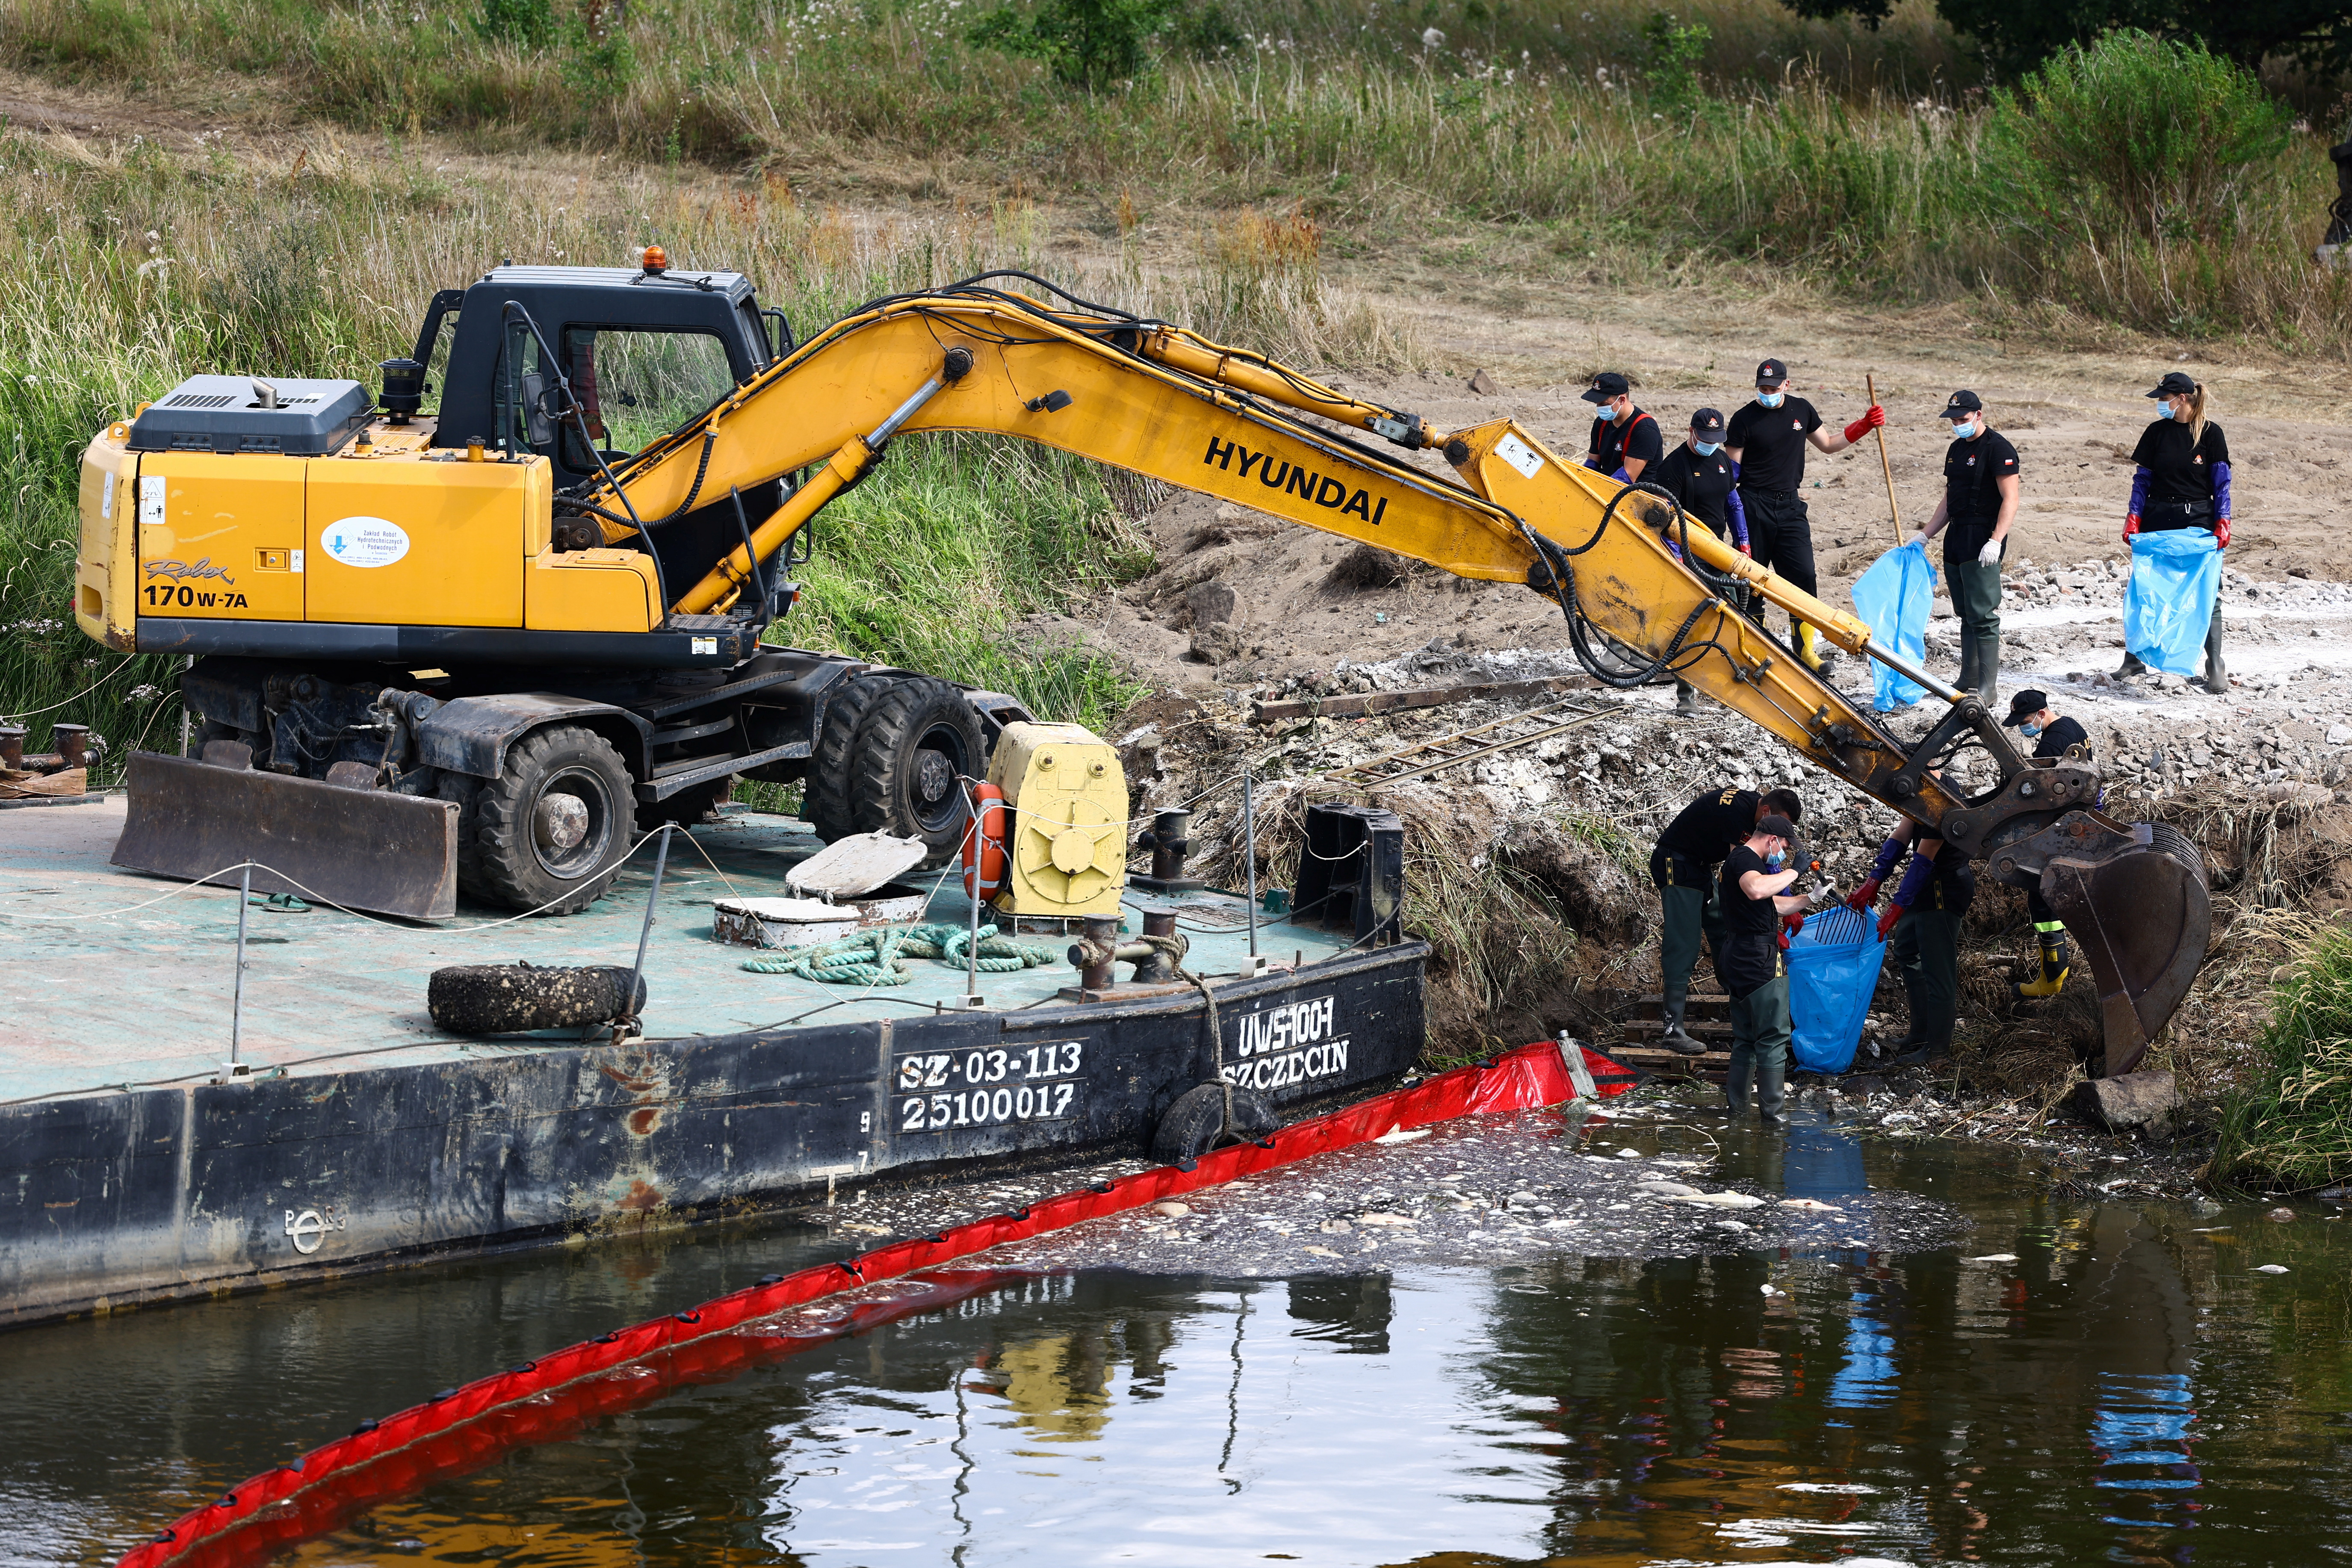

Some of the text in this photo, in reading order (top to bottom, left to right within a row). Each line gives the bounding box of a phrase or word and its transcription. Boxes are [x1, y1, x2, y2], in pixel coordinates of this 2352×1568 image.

[1204, 436, 1388, 526] HYUNDAI
[358, 537, 402, 545] Hydrotechnicznych
[143, 557, 235, 585] Robex
[144, 585, 194, 606] 170
[900, 1042, 1082, 1089] SZ-03-113
[1222, 1040, 1349, 1090] SZCZECIN
[902, 1084, 1074, 1130] 25100017
[860, 1111, 870, 1133] 9
[858, 1151, 868, 1172] 7
[285, 1209, 294, 1228] P
[325, 1205, 335, 1224] R
